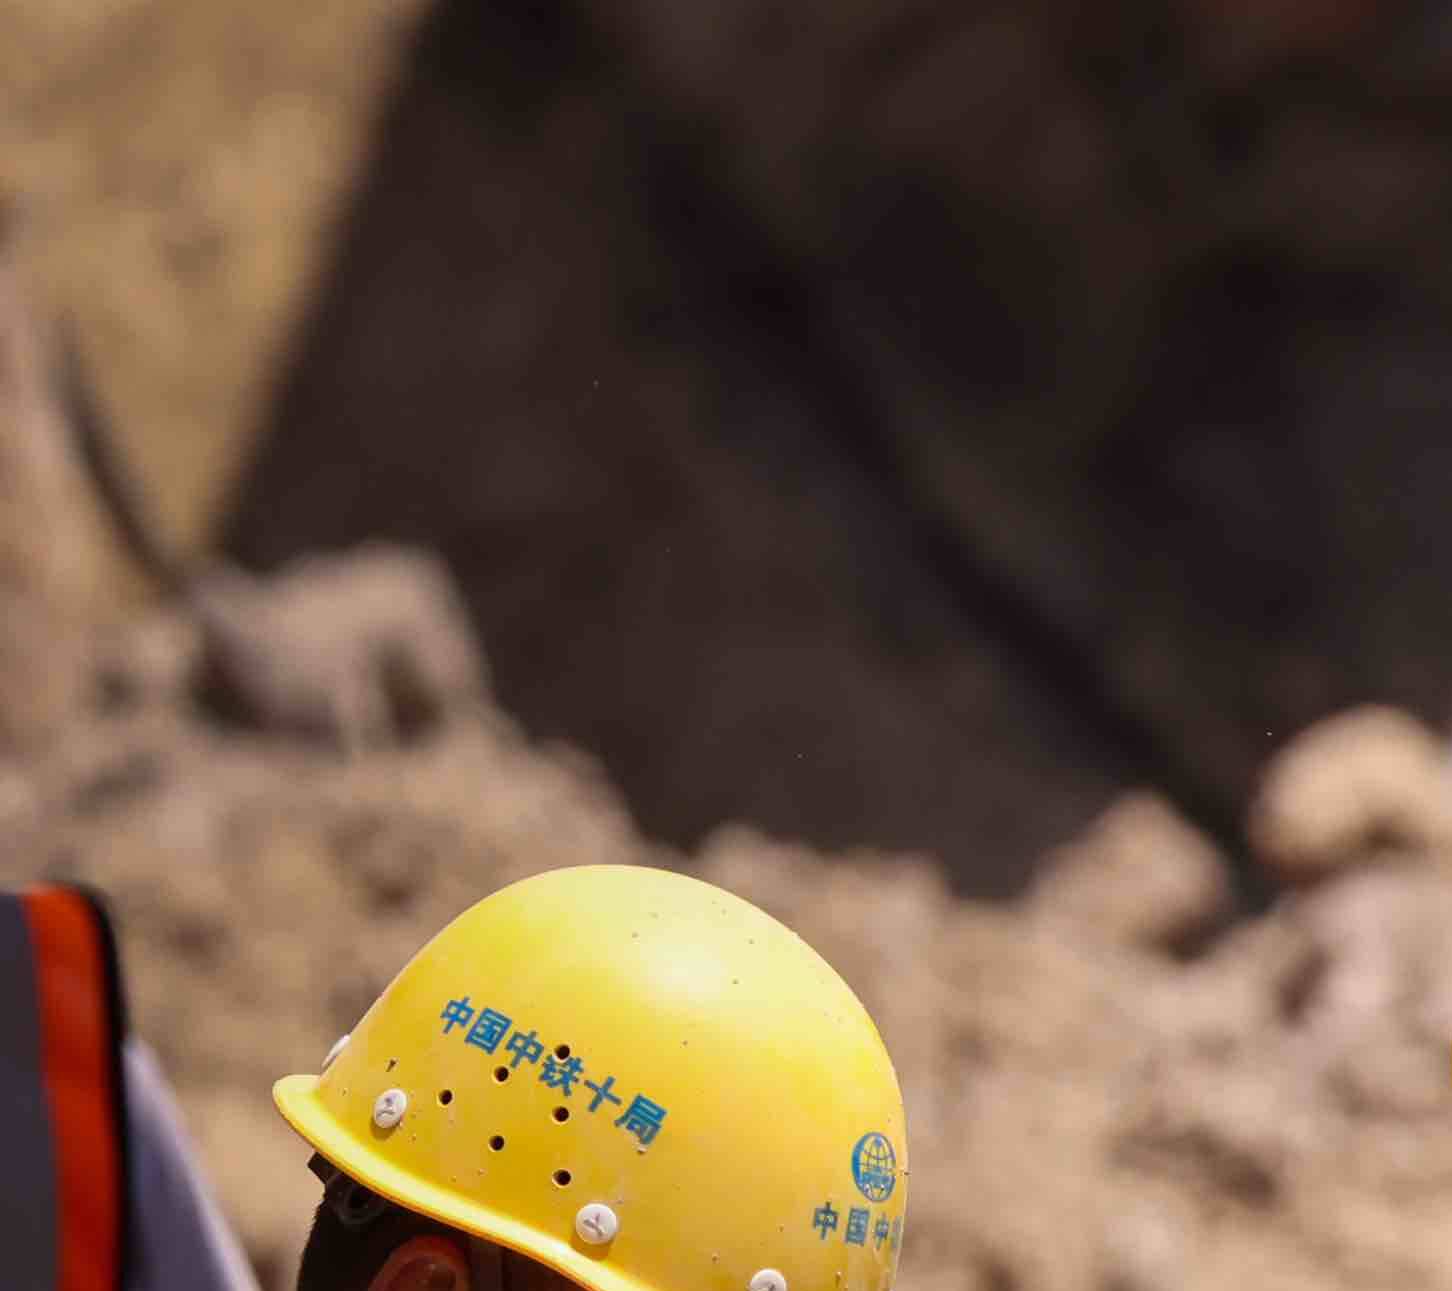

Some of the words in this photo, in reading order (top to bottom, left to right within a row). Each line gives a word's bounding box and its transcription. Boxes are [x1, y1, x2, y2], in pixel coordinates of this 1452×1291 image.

[439, 994, 669, 1146] 中国中铁十局
[812, 1200, 903, 1251] 中国中
